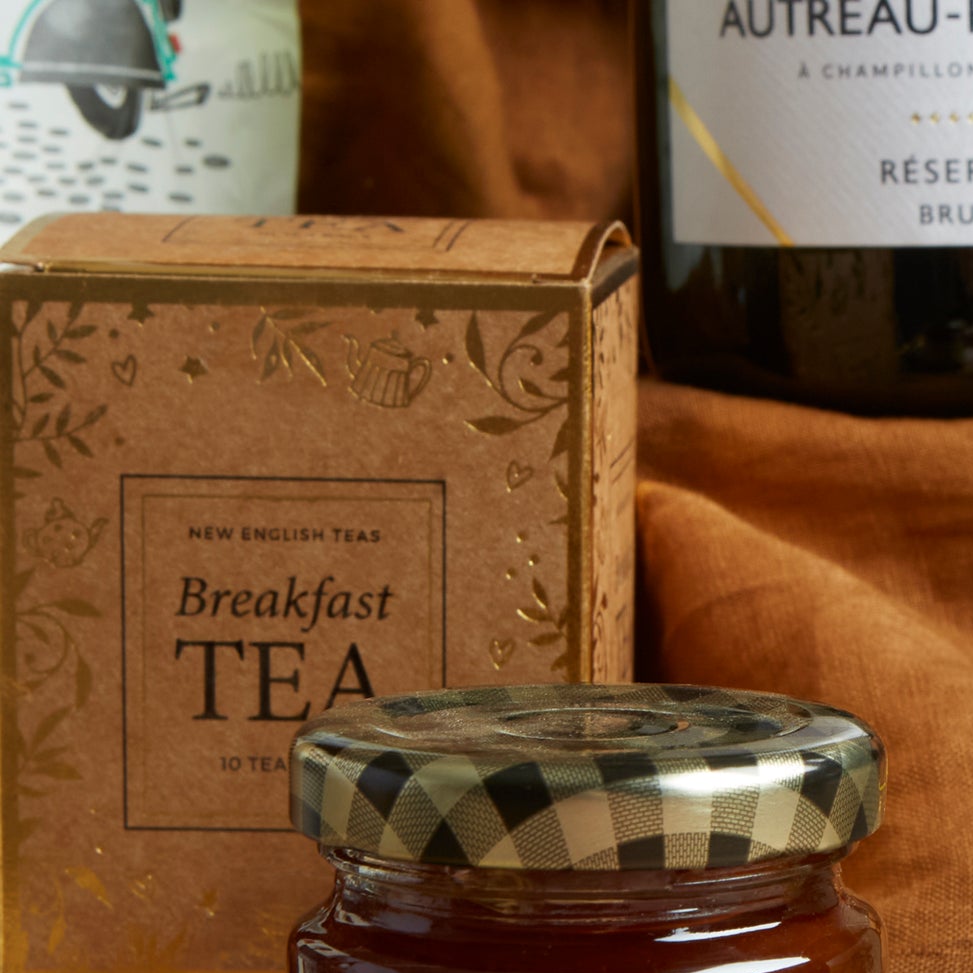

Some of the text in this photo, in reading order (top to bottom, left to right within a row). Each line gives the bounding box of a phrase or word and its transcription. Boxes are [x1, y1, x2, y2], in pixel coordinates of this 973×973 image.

[189, 526, 382, 543] NEW ENGLISH TEAS
[175, 575, 394, 633] Breakfast
[175, 638, 376, 722] TEA
[220, 756, 242, 771] 10
